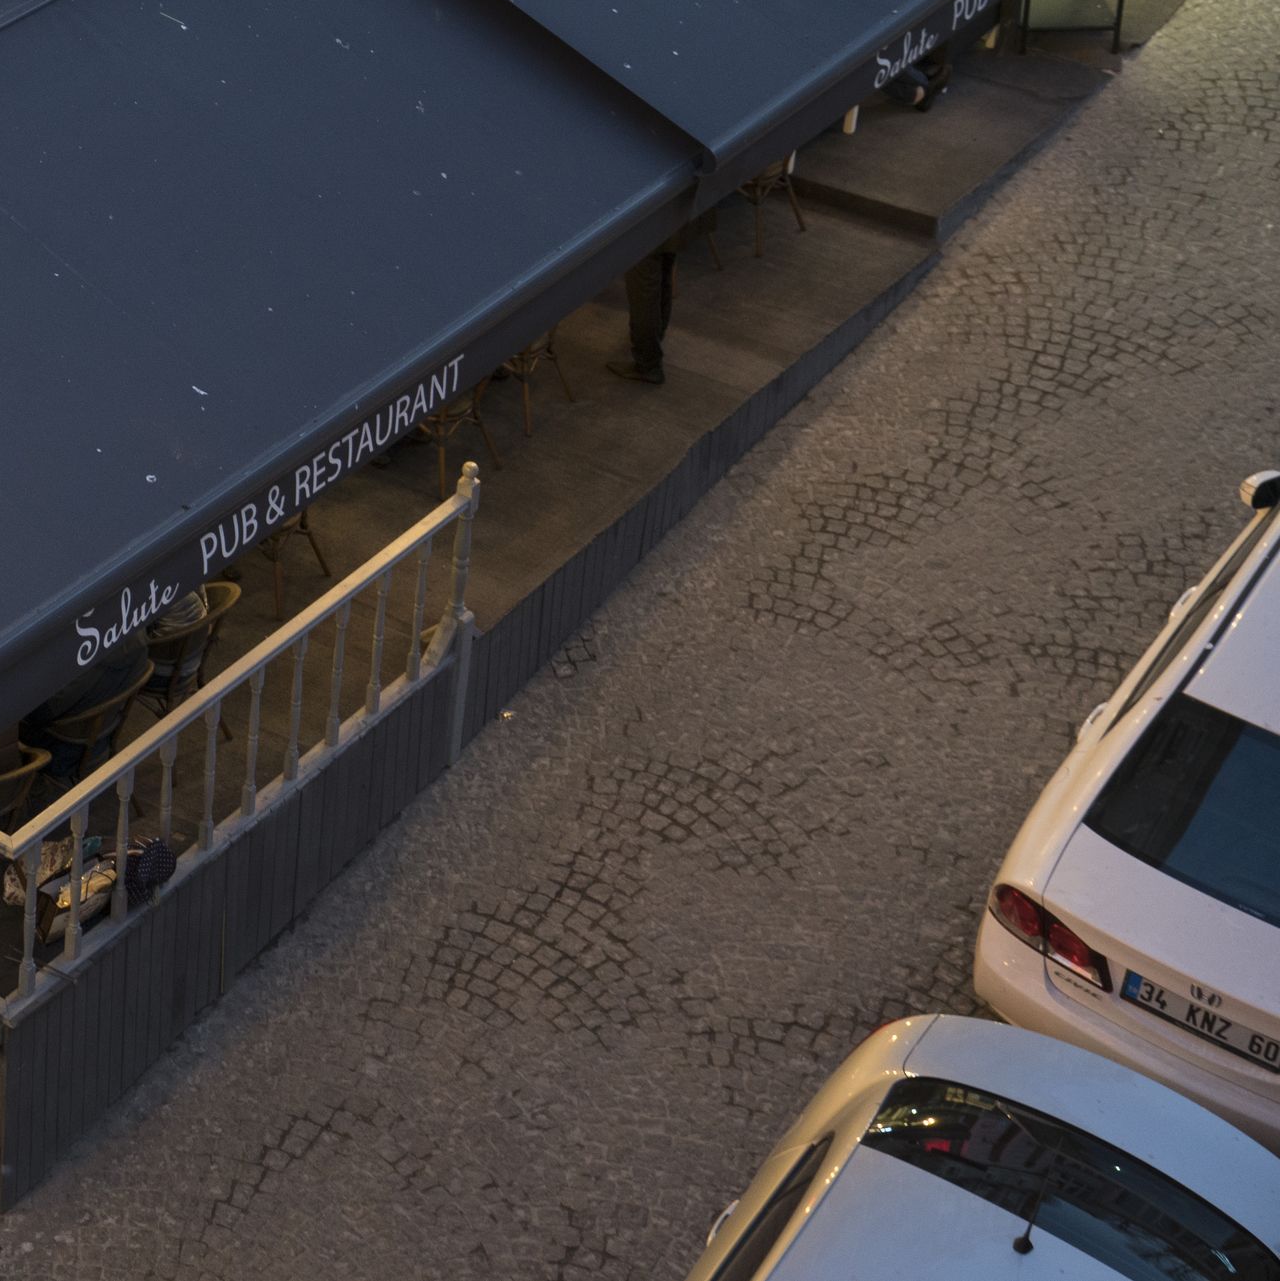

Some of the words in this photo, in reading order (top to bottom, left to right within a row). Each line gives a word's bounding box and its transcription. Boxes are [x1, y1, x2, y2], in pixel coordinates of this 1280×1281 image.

[874, 27, 939, 89] Salute
[76, 578, 180, 667] Salute
[199, 502, 258, 576] PUB
[265, 484, 286, 525] &
[294, 353, 465, 507] RESTAURANT
[1140, 981, 1167, 1010] 34
[1185, 1004, 1233, 1042] KNZ
[1248, 1034, 1280, 1064] 60
